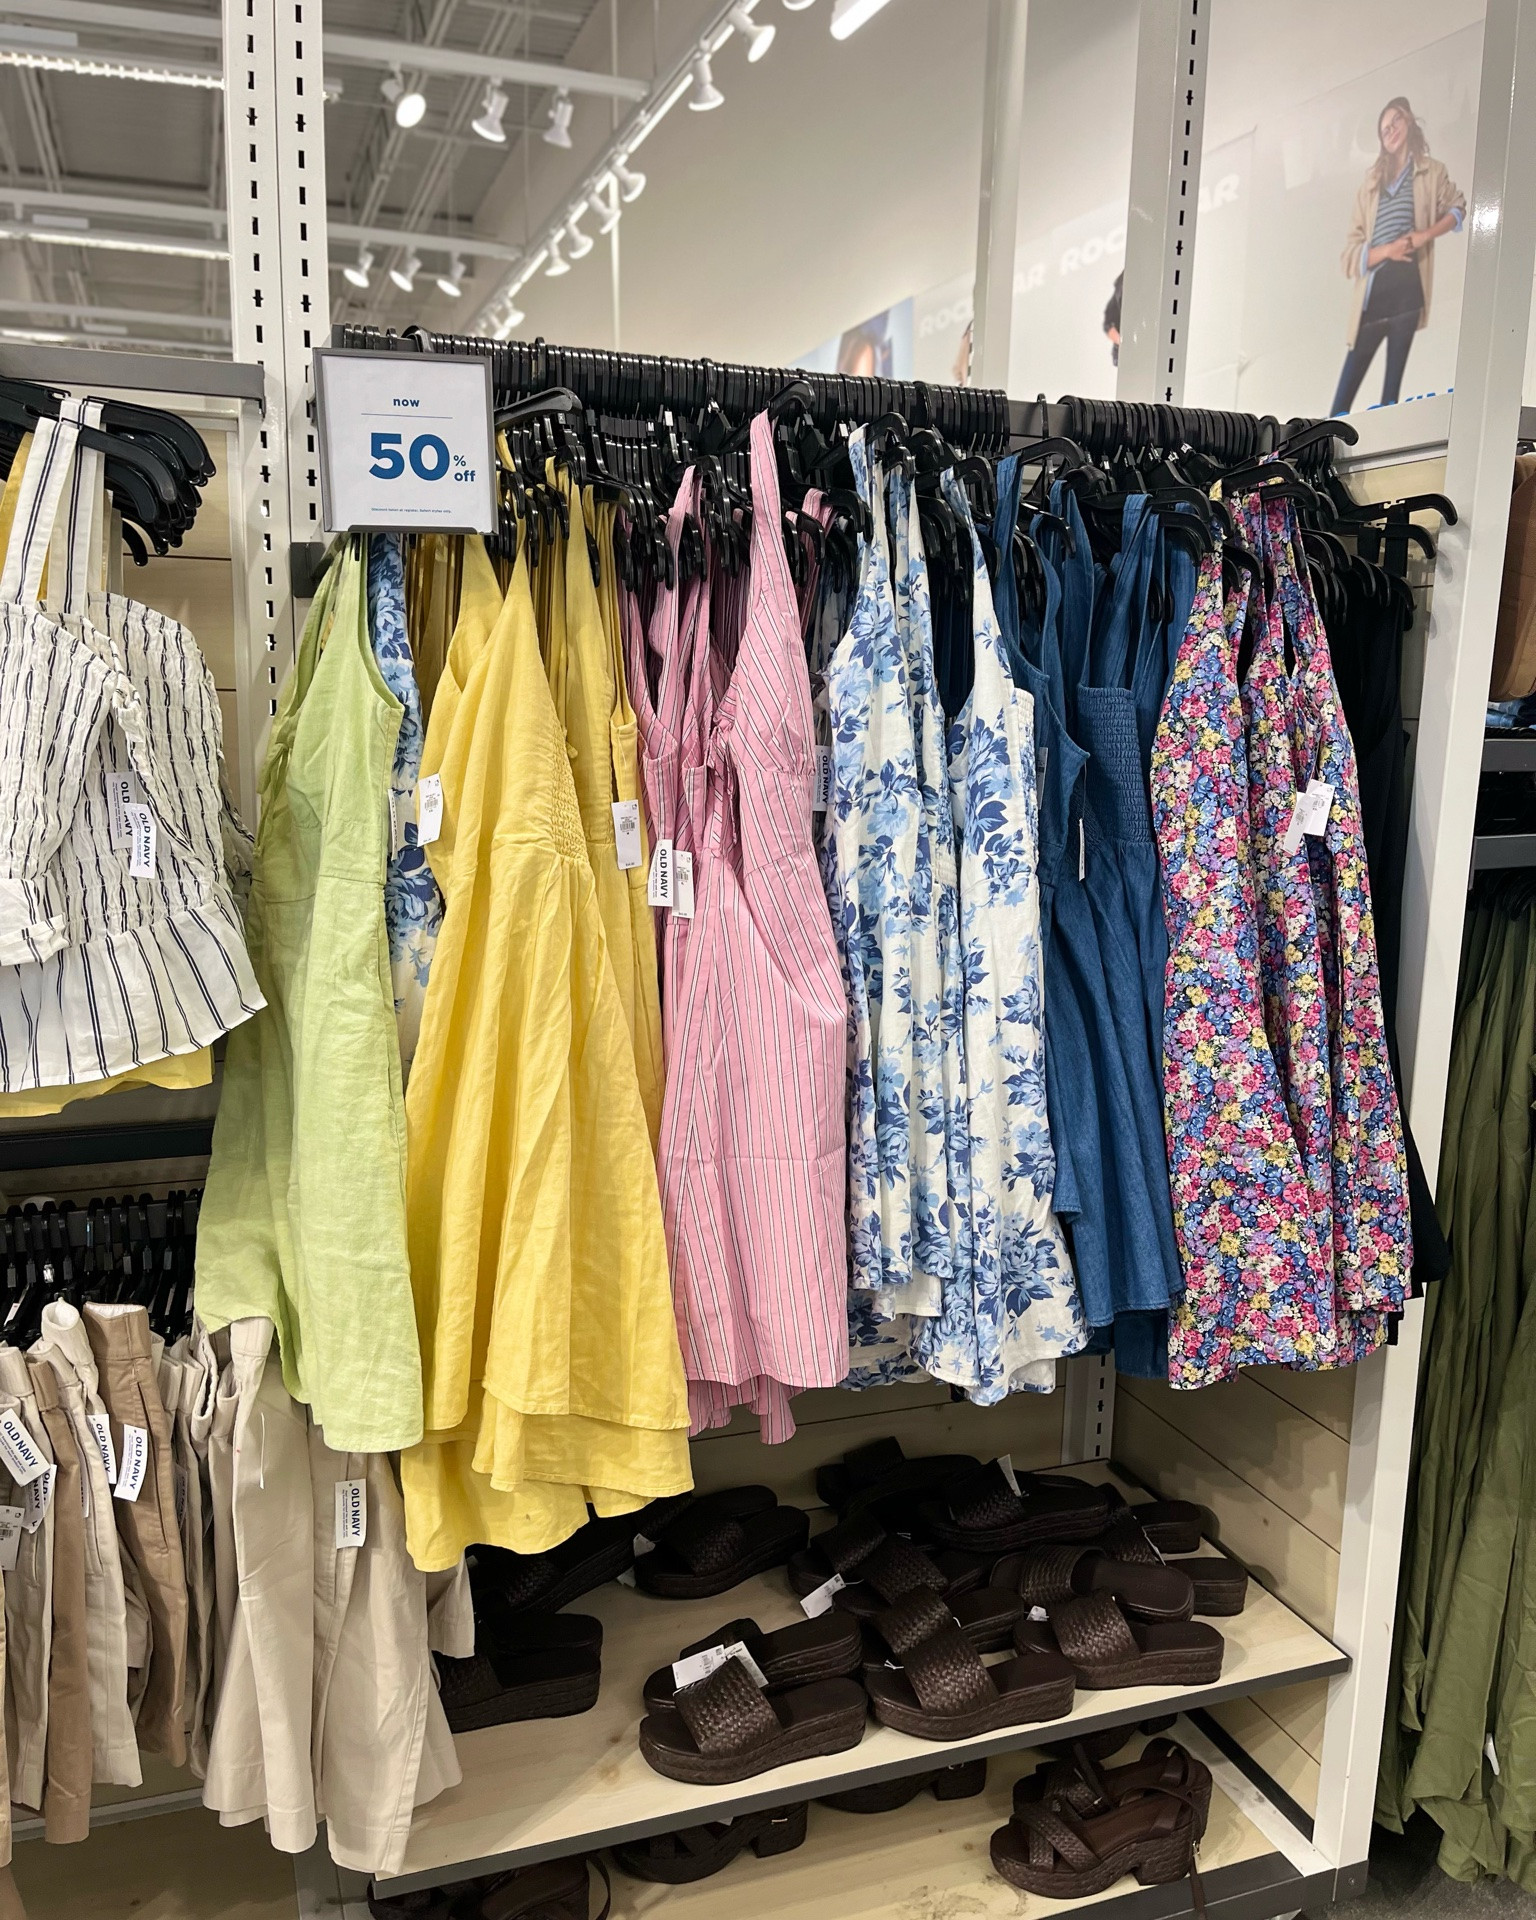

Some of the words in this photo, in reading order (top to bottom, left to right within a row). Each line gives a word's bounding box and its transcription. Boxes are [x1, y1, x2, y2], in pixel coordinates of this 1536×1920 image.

[393, 398, 420, 407] now
[454, 470, 476, 482] off
[120, 781, 130, 804] OLD
[139, 812, 151, 833] OLD
[143, 836, 151, 867] NAVY
[660, 870, 668, 898] NAVY
[4, 1421, 20, 1441] OLD
[16, 1440, 38, 1467] NAVY
[96, 1423, 106, 1442] OLD
[129, 1459, 141, 1490] NAVY
[351, 1488, 360, 1508] OLD
[351, 1509, 360, 1536] NAVY
